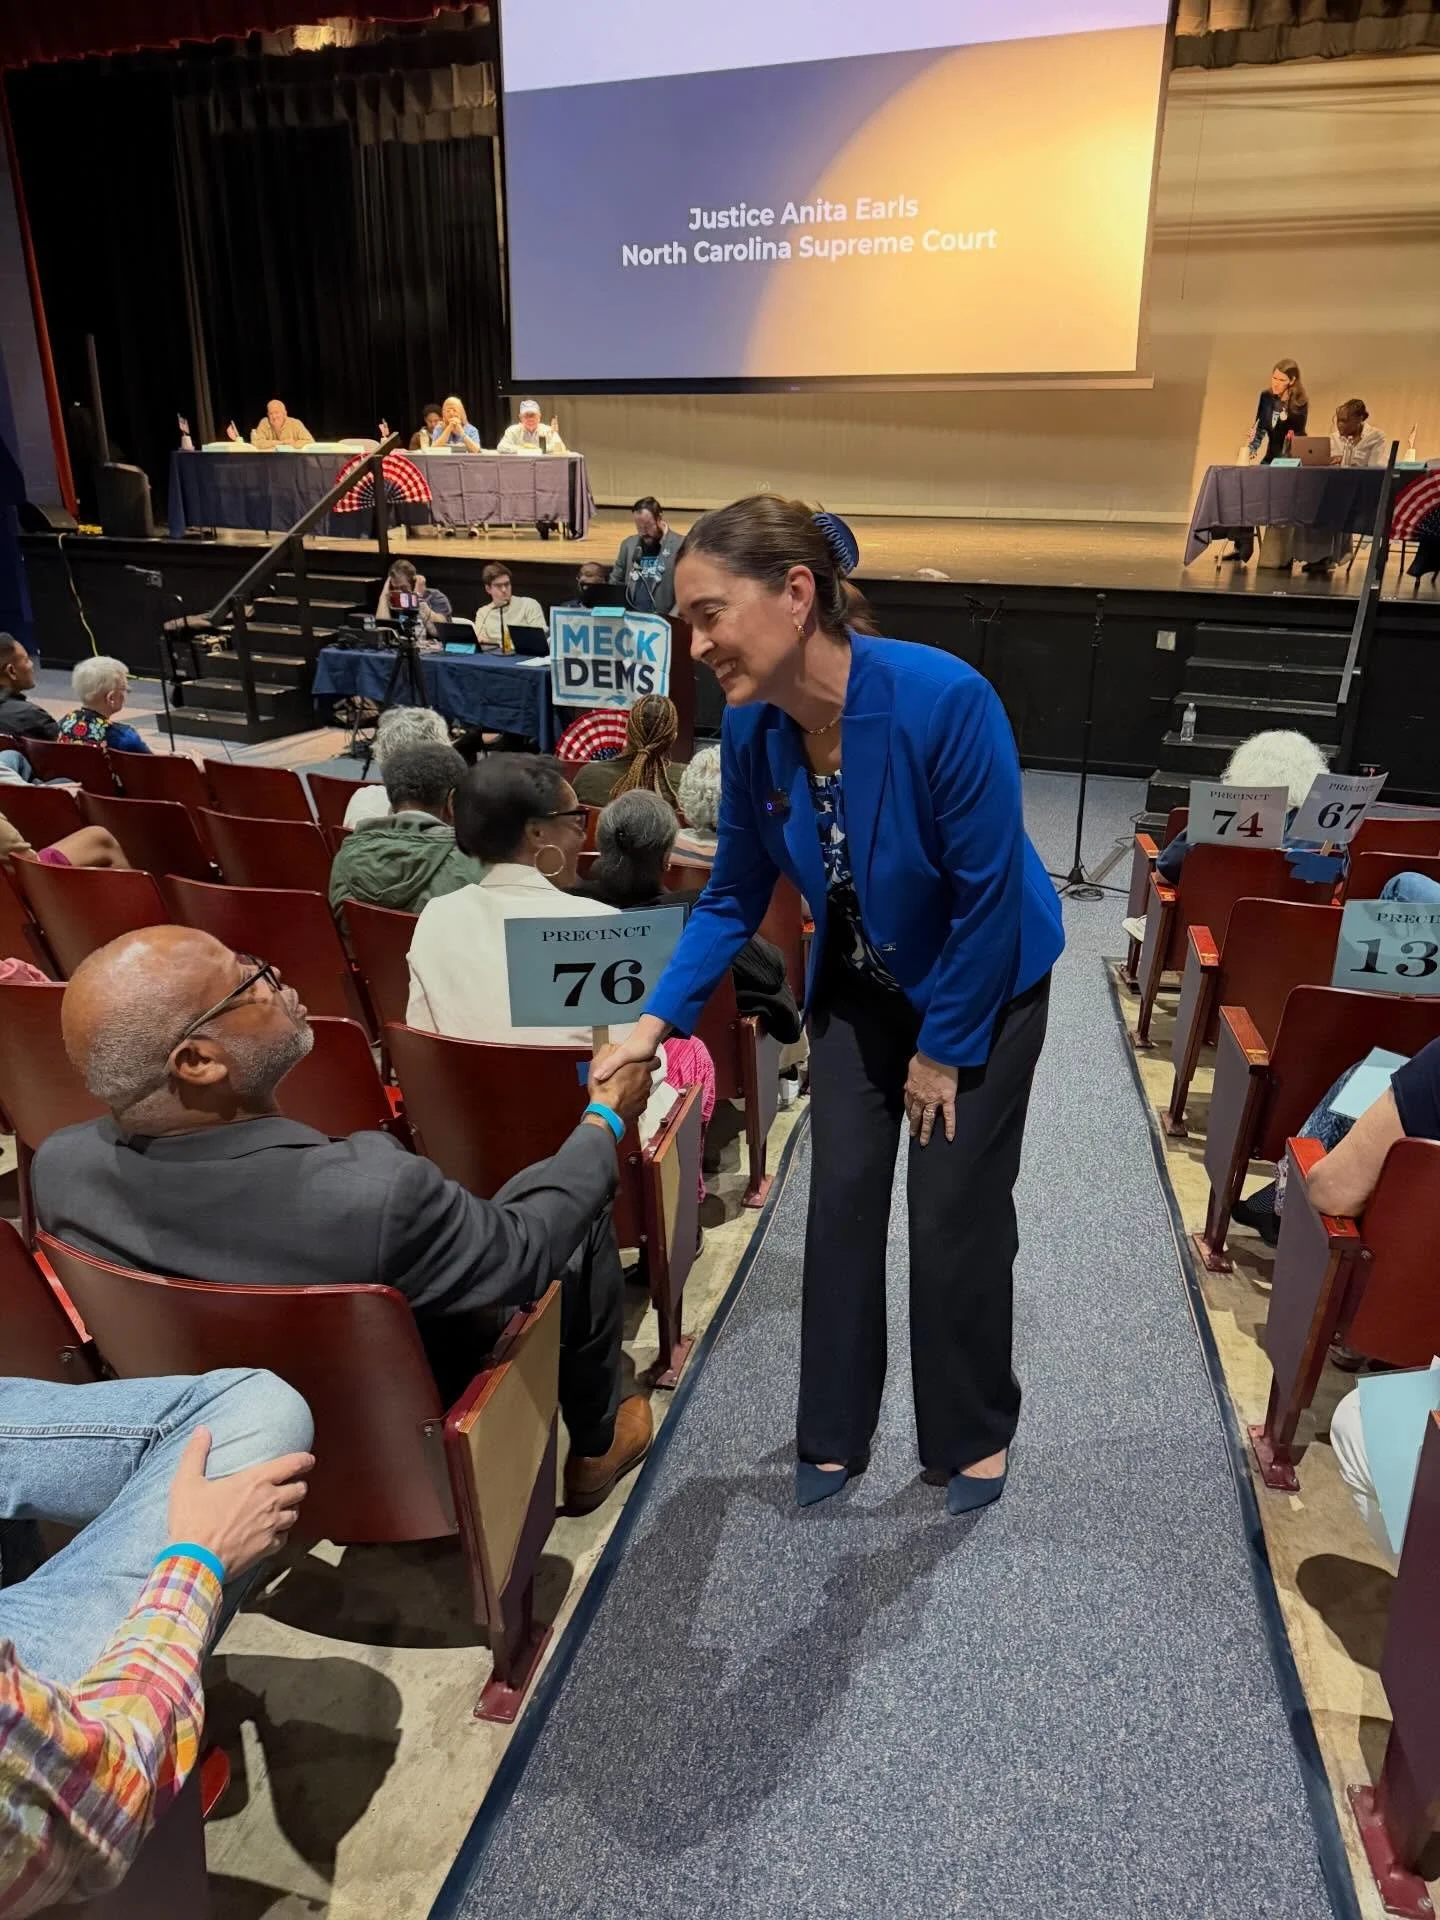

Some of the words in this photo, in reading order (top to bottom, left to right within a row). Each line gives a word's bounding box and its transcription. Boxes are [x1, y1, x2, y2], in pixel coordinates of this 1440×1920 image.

[689, 203, 775, 231] Justice
[780, 198, 847, 225] Anita
[855, 194, 919, 220] Earls
[622, 242, 687, 267] North
[693, 235, 792, 264] Carolina
[799, 231, 914, 262] Supreme
[922, 227, 998, 253] Court
[562, 624, 660, 662] MECK
[564, 657, 655, 695] DEMS
[1209, 790, 1271, 801] PRECINCT
[1328, 783, 1379, 793] PRECINC
[1212, 809, 1264, 838] 74
[1317, 802, 1366, 829] 67
[541, 925, 651, 942] PRECINCT
[1376, 912, 1440, 924] PRECI
[1350, 938, 1439, 978] 13
[552, 959, 645, 1007] 76
